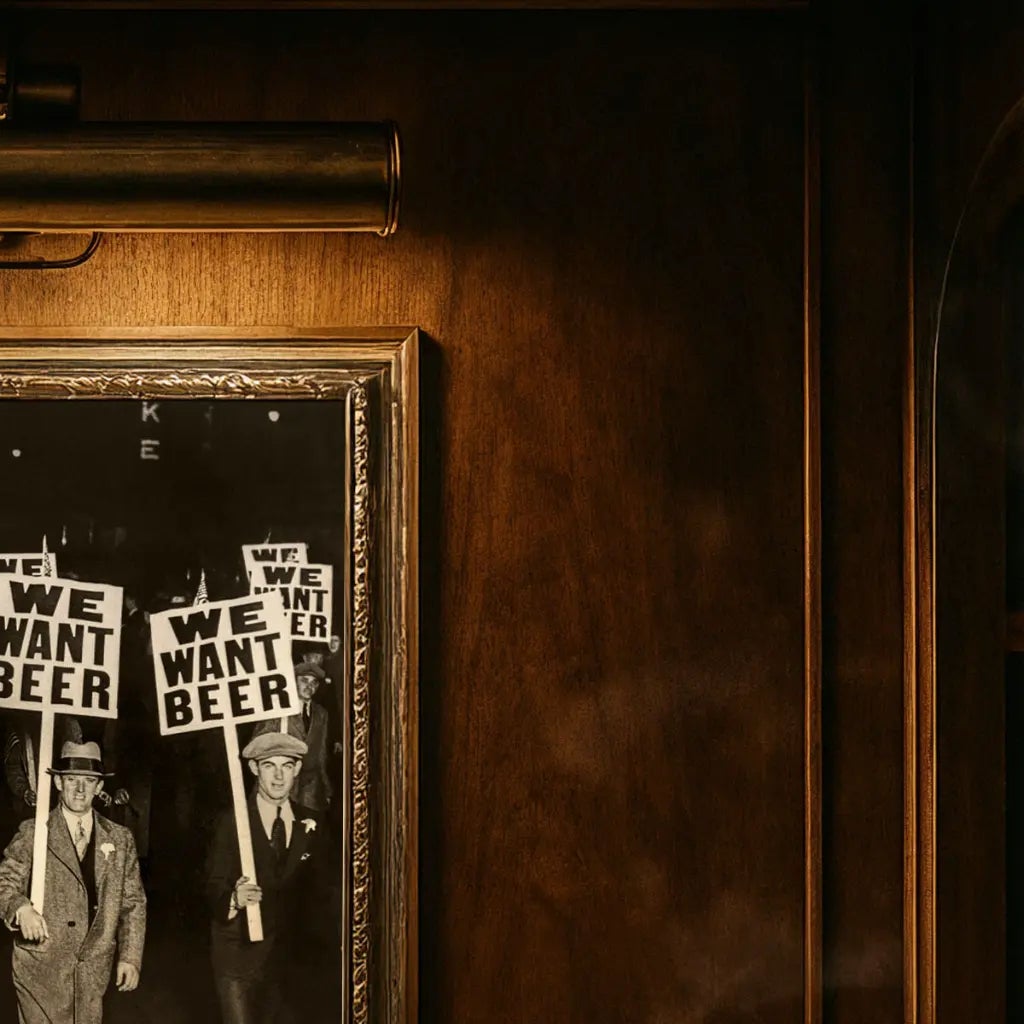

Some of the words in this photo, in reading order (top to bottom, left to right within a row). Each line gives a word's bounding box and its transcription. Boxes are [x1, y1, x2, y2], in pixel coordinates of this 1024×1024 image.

[262, 566, 322, 587] WE
[9, 581, 104, 623] WE
[168, 601, 267, 645] WE
[160, 632, 280, 688] WANT
[164, 674, 292, 728] BEER
